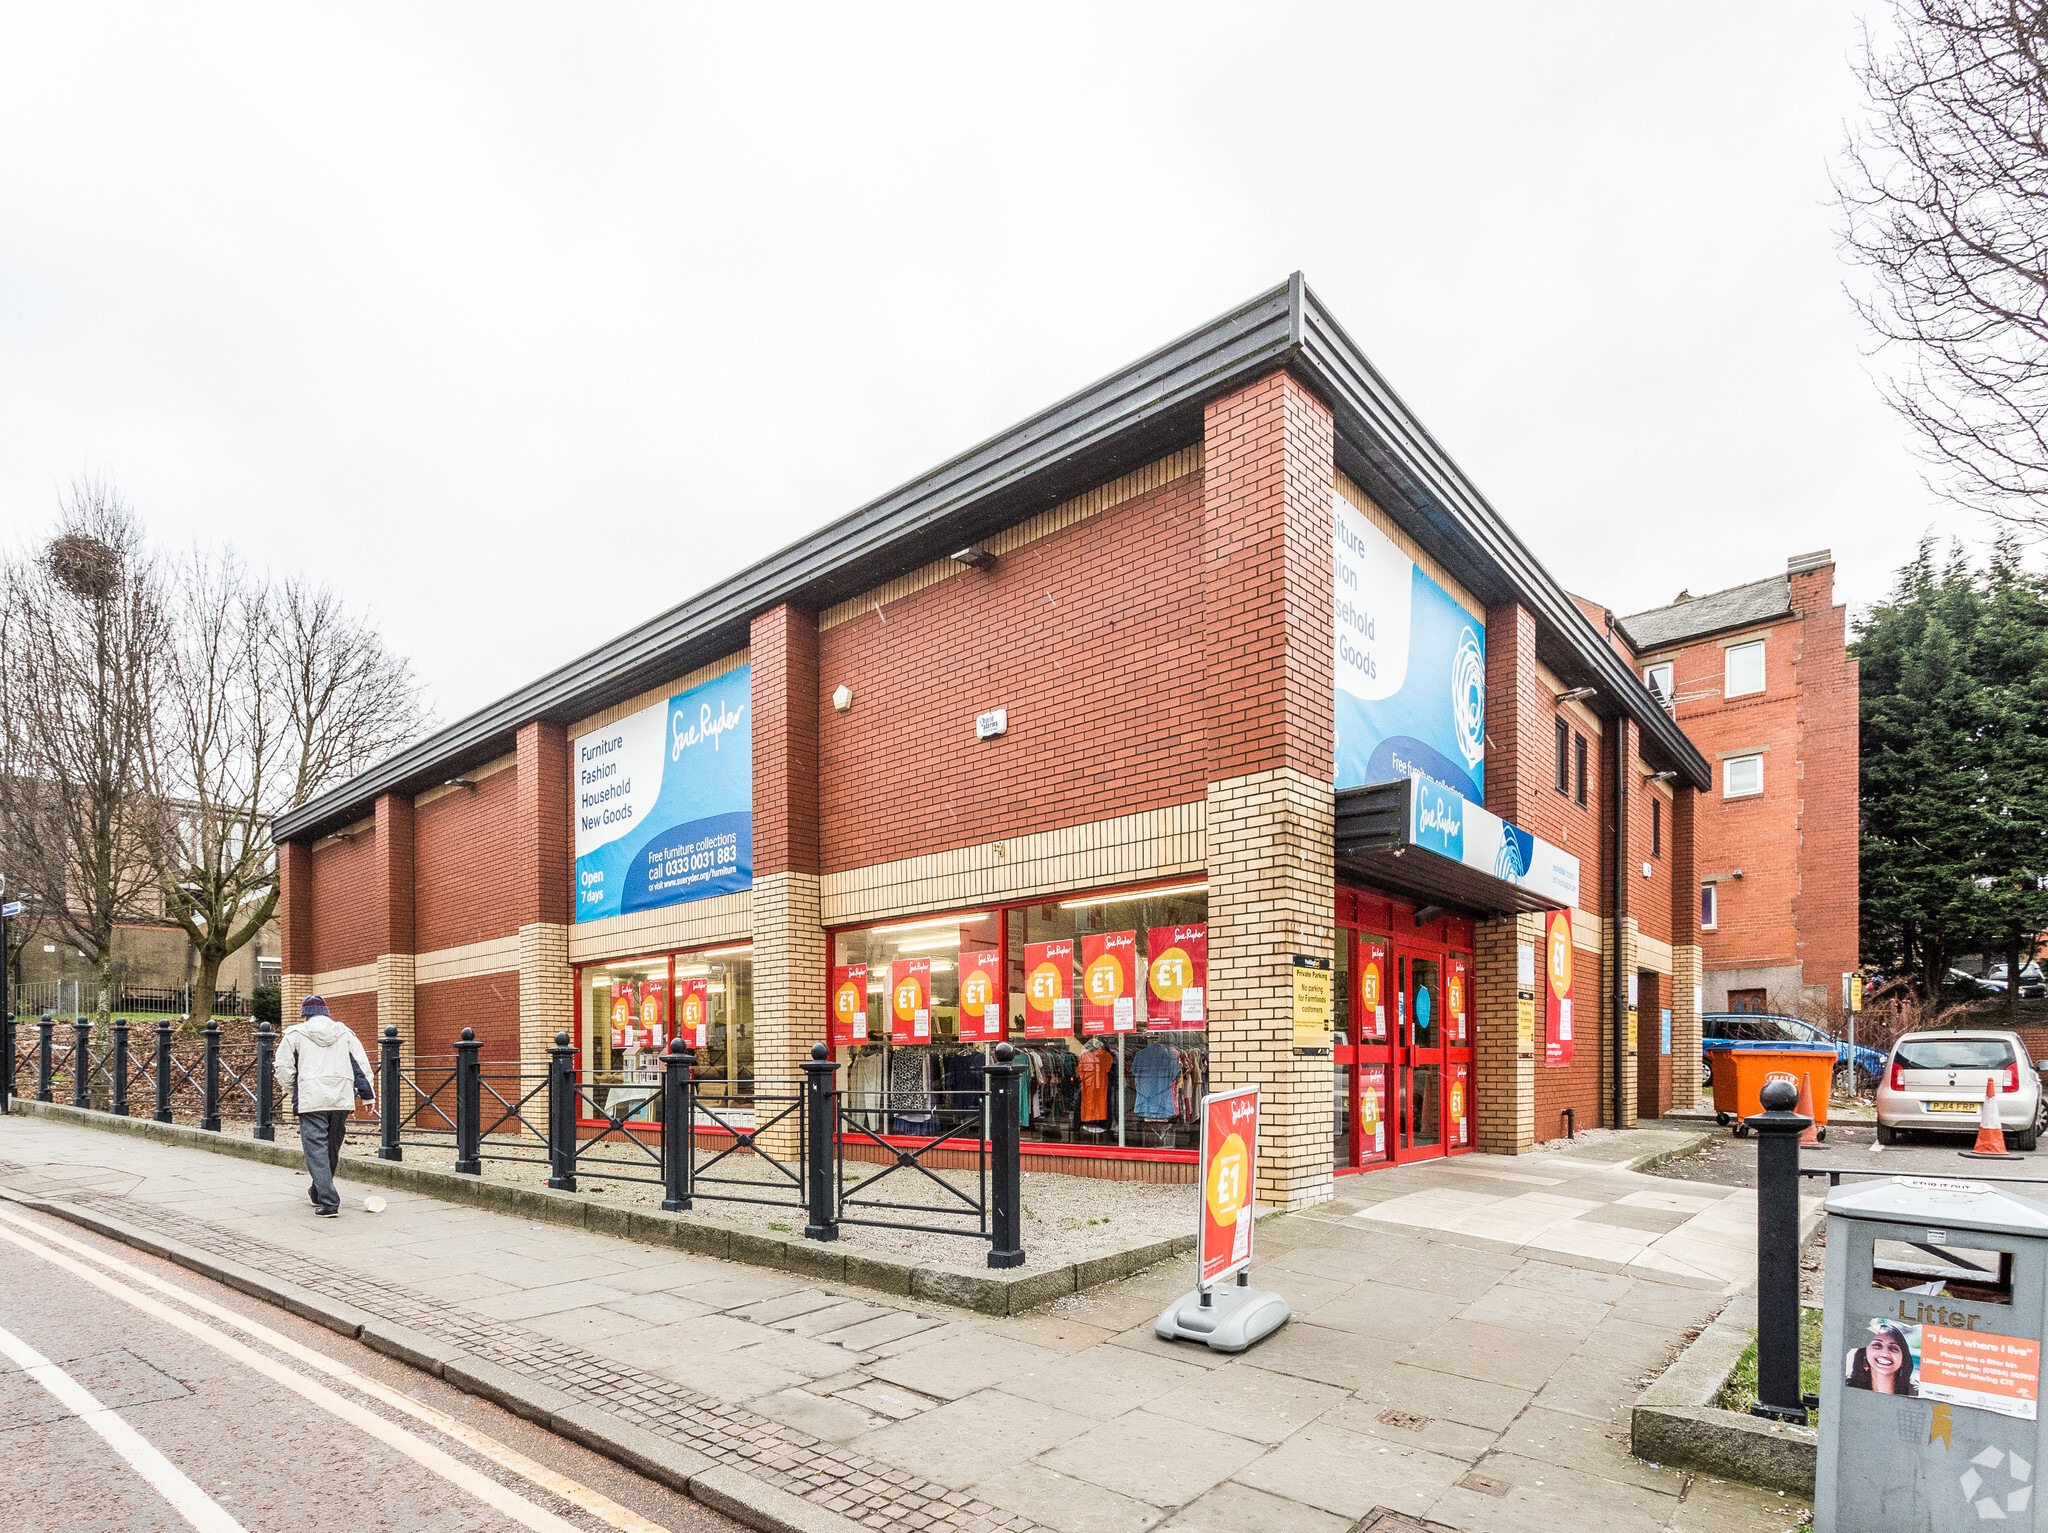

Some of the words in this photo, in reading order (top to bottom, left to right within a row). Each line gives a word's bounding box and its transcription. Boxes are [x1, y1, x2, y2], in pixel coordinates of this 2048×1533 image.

[1339, 633, 1377, 680] Goods
[672, 710, 700, 762] Sue
[700, 700, 745, 752] Ryder
[581, 736, 623, 763] Furniture
[1392, 752, 1407, 775] Free
[581, 762, 617, 786] Fashion
[581, 777, 631, 809] Household
[581, 815, 601, 832] New
[603, 803, 633, 825] Goods
[1420, 785, 1436, 833] Sue
[1436, 797, 1460, 848] Ryder
[648, 851, 663, 864] Free
[664, 843, 694, 860] furniture
[696, 832, 736, 852] collections
[648, 863, 663, 881] call
[665, 857, 689, 877] 0333
[690, 850, 715, 871] 0031
[717, 845, 736, 865] 883
[581, 871, 604, 888] Open
[648, 884, 654, 892] or
[654, 881, 664, 890] visit
[664, 865, 736, 887] www.sueryder.org/furniture
[581, 890, 587, 904] 7
[587, 890, 604, 904] days
[1106, 936, 1116, 950] Sue
[1116, 936, 1133, 949] Ryder
[1174, 928, 1187, 943] Sue
[1187, 928, 1205, 943] Ryder
[977, 953, 987, 967] Sue
[987, 954, 999, 966] Ryder
[1046, 945, 1057, 958] Sue
[1057, 945, 1072, 958] Ryder
[1553, 941, 1565, 977] £1
[1091, 971, 1115, 993] £1
[1157, 963, 1183, 987] £1
[1296, 969, 1312, 978] Private
[1312, 971, 1328, 981] Parking
[966, 984, 985, 1004] £1
[1033, 977, 1055, 998] £1
[1308, 985, 1323, 995] parking
[1365, 979, 1376, 999] £1
[839, 994, 855, 1012] £1
[898, 990, 915, 1009] £1
[1451, 989, 1459, 1007] £1
[615, 1006, 626, 1022] £1
[643, 1006, 654, 1021] £1
[685, 1005, 698, 1021] £1
[1301, 1006, 1323, 1014] customers
[1365, 1101, 1376, 1122] £1
[1452, 1095, 1460, 1112] £1
[1933, 1102, 1953, 1110] PJ14
[1956, 1103, 1975, 1111] FRP
[1218, 1163, 1240, 1205] £1
[1899, 1300, 1981, 1331] Litter
[1938, 1335, 1962, 1347] love
[1963, 1340, 1999, 1353] where
[2001, 1344, 2005, 1353] I
[1922, 1358, 1942, 1366] Litter
[1942, 1361, 1965, 1370] report
[1939, 1351, 1965, 1360] Please
[1965, 1356, 1979, 1364] use
[1986, 1358, 2005, 1367] litter
[2005, 1361, 2018, 1369] bin
[1941, 1369, 1958, 1377] Fine
[1958, 1371, 1970, 1379] for
[1970, 1373, 1998, 1385] littering
